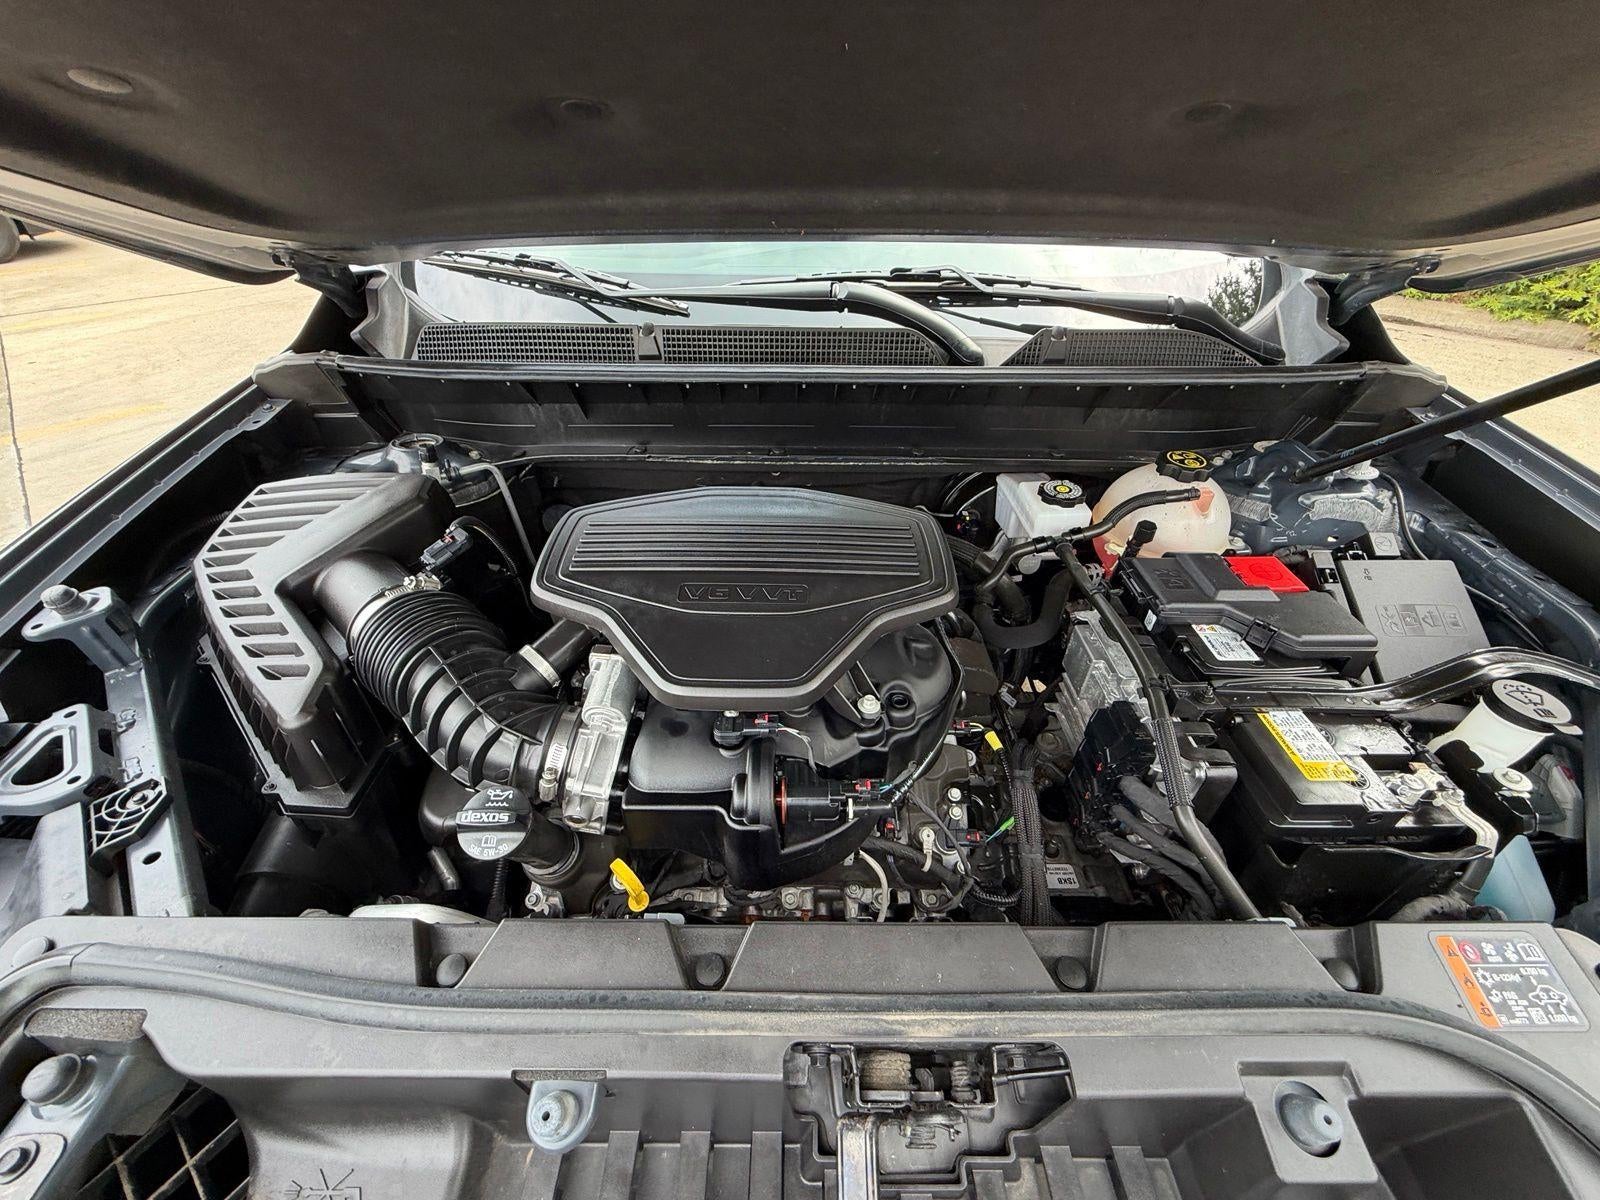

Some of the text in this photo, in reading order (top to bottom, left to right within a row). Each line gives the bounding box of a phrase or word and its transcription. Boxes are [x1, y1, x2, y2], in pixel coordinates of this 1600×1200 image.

[684, 586, 804, 601] V6 VVT
[460, 810, 511, 822] dexos
[468, 843, 509, 857] SAE 5W-30
